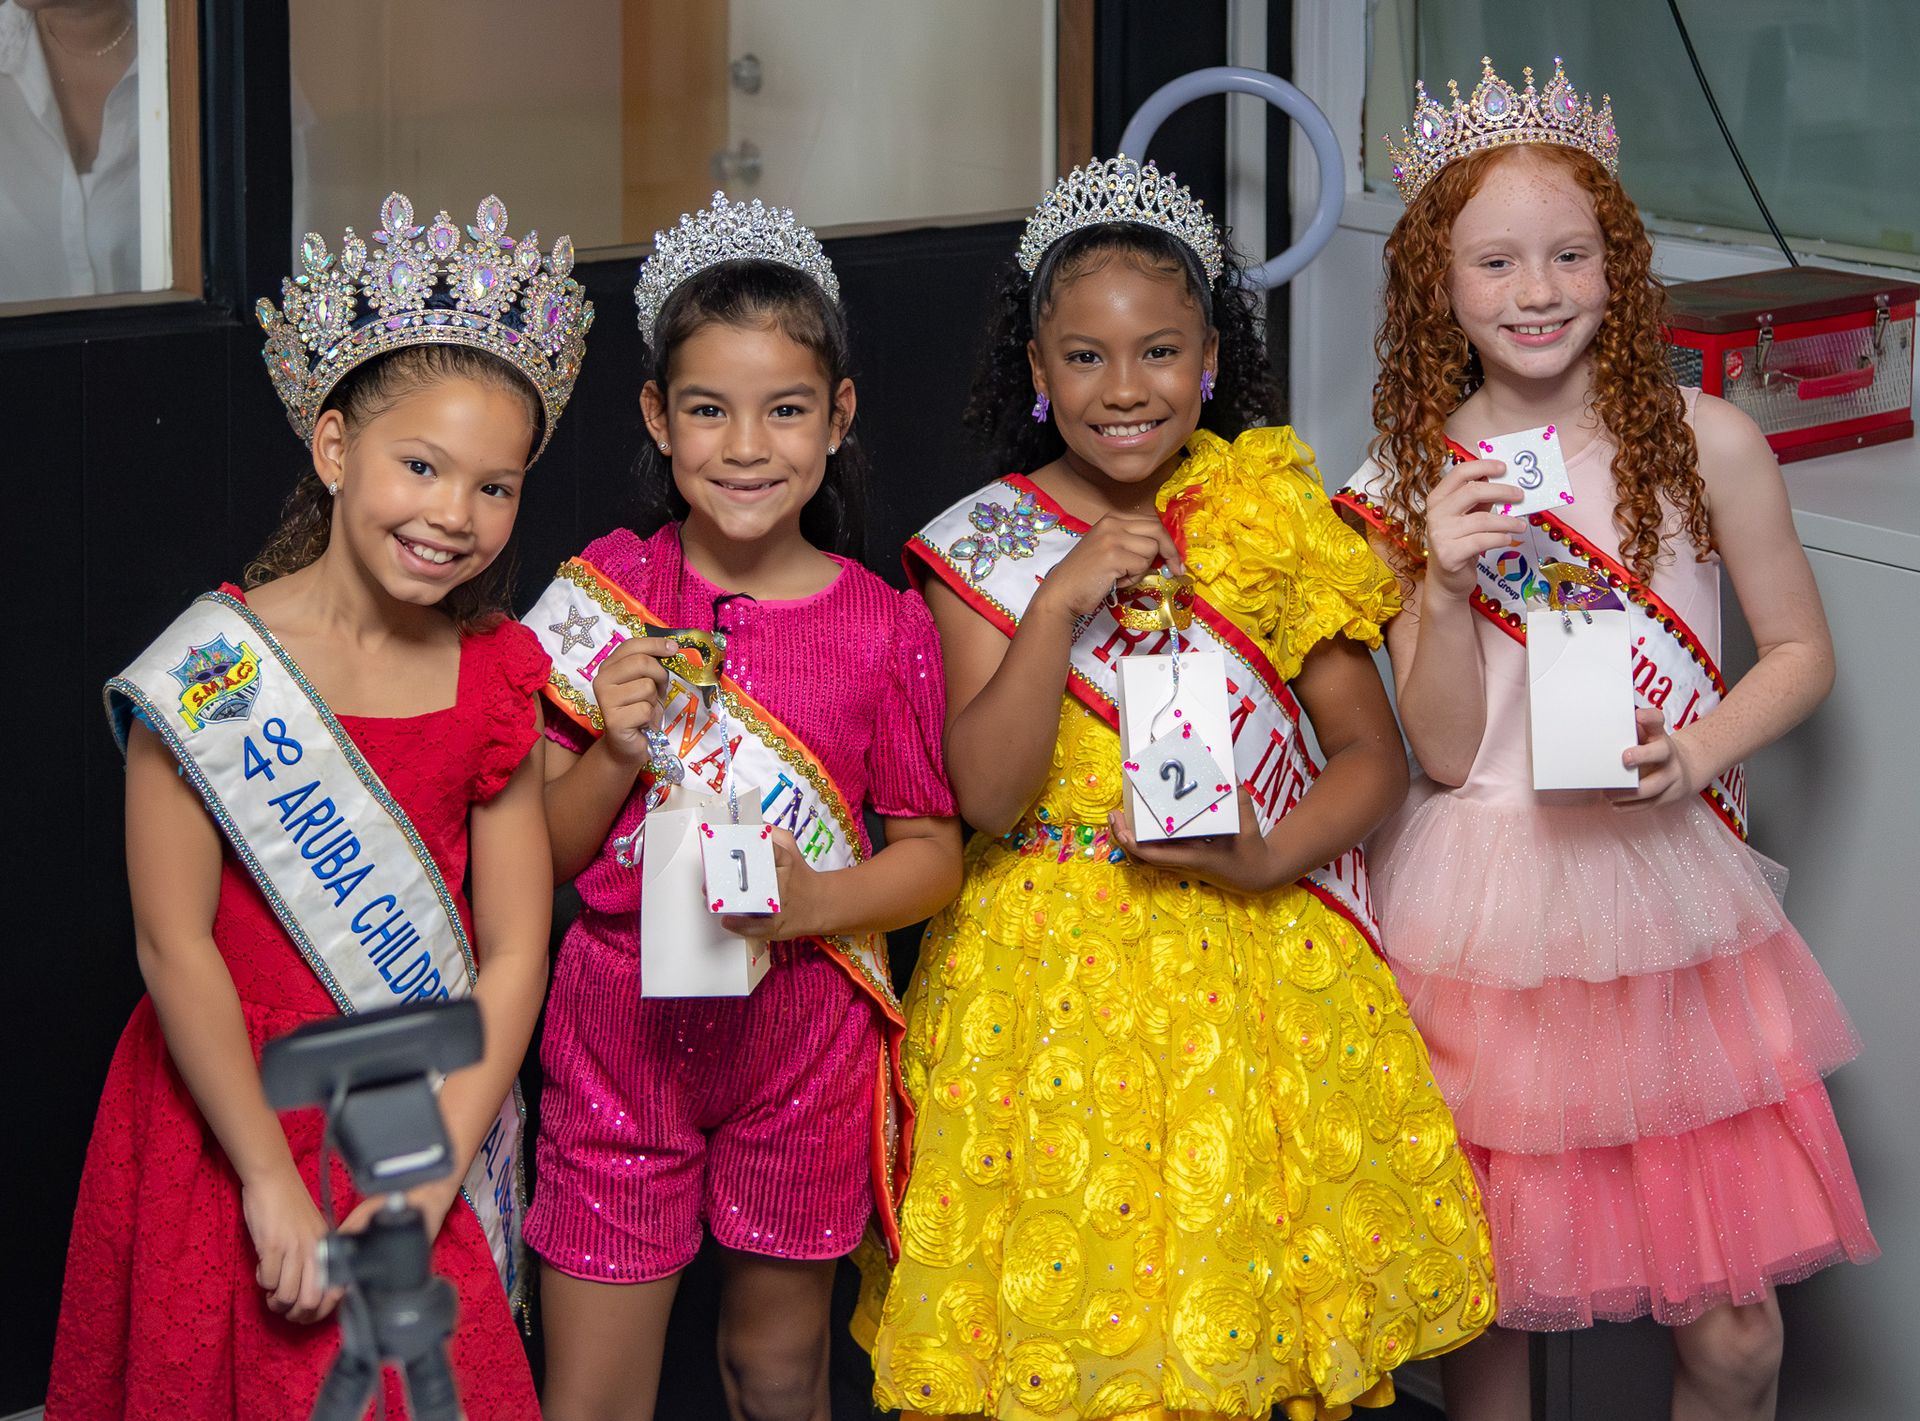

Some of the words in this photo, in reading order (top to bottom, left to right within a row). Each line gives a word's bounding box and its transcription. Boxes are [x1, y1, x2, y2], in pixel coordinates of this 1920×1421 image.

[1513, 449, 1545, 490] 3
[1497, 578, 1521, 600] Group
[243, 717, 303, 782] 48
[1160, 758, 1198, 800] 2
[267, 780, 377, 908] ARUBA
[729, 849, 750, 893] 1
